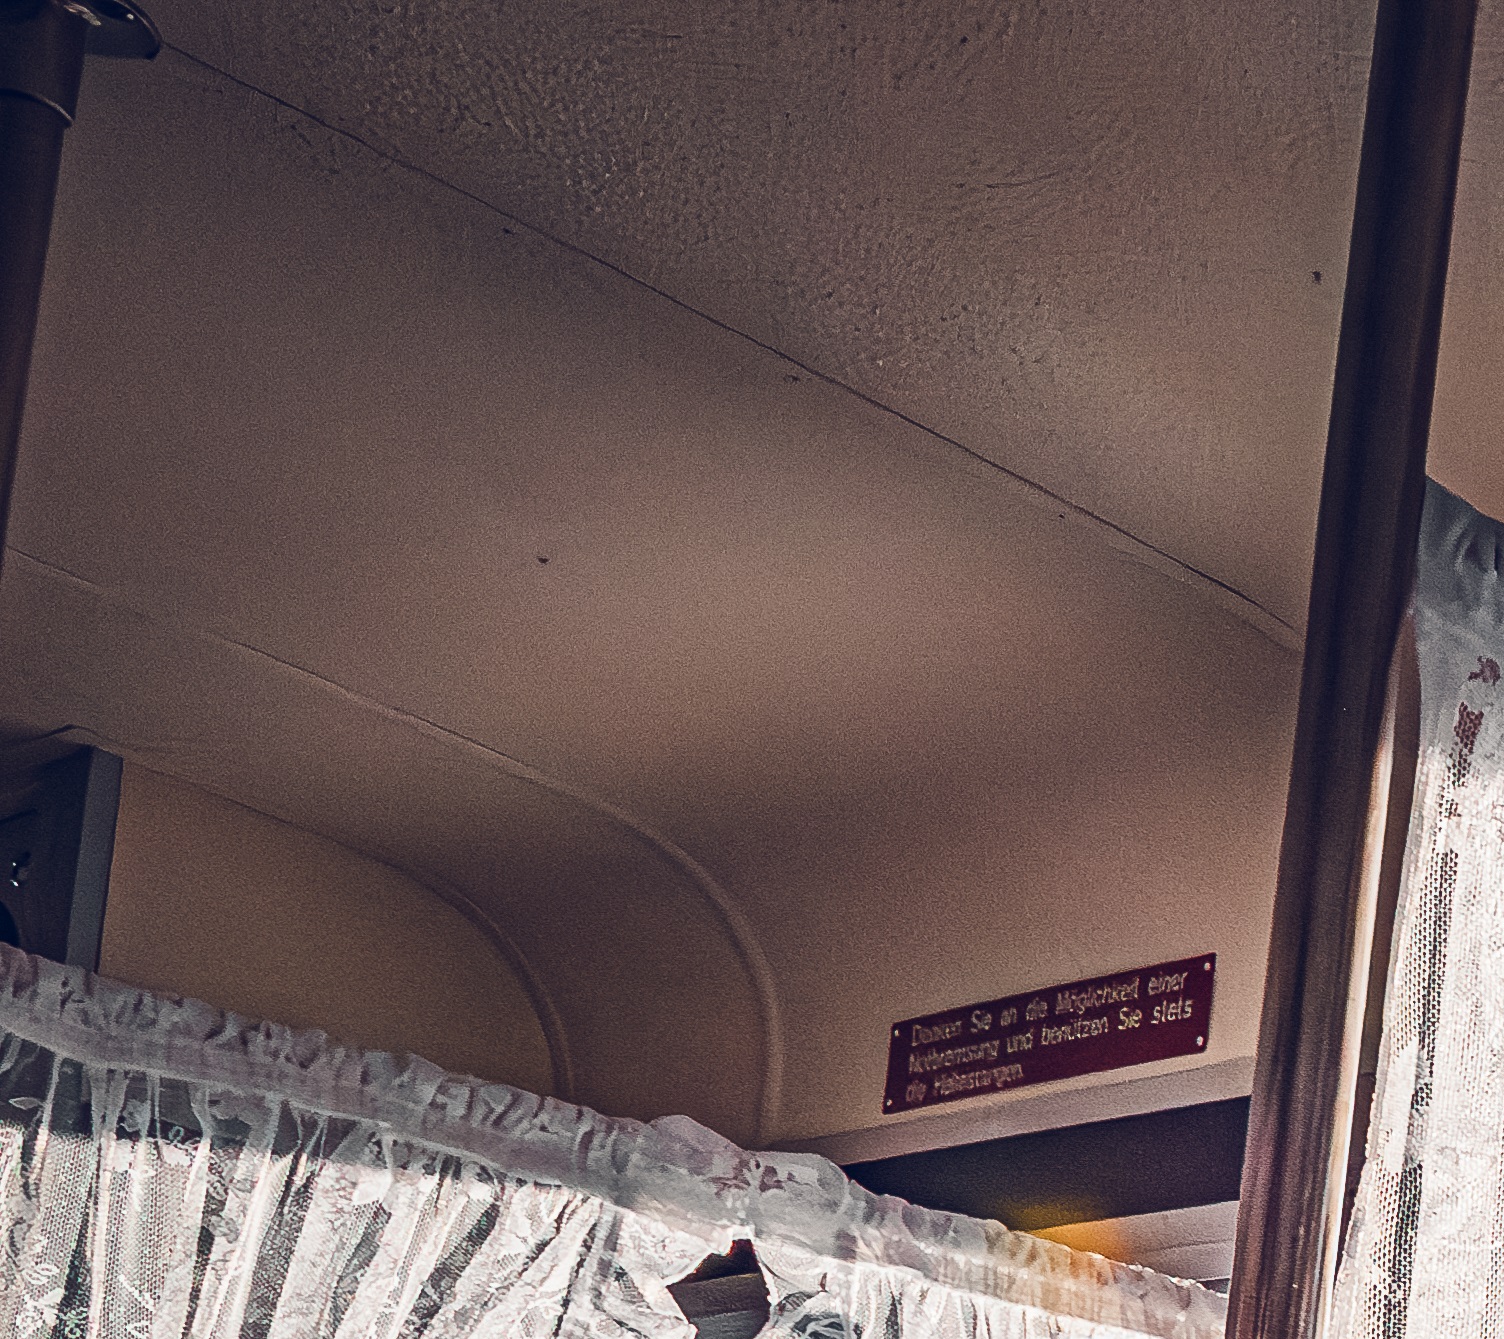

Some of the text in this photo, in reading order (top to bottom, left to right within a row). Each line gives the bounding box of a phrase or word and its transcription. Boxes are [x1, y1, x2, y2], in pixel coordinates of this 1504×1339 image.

[1148, 970, 1189, 996] einer
[1117, 1005, 1143, 1032] Sie
[1150, 997, 1193, 1026] stets
